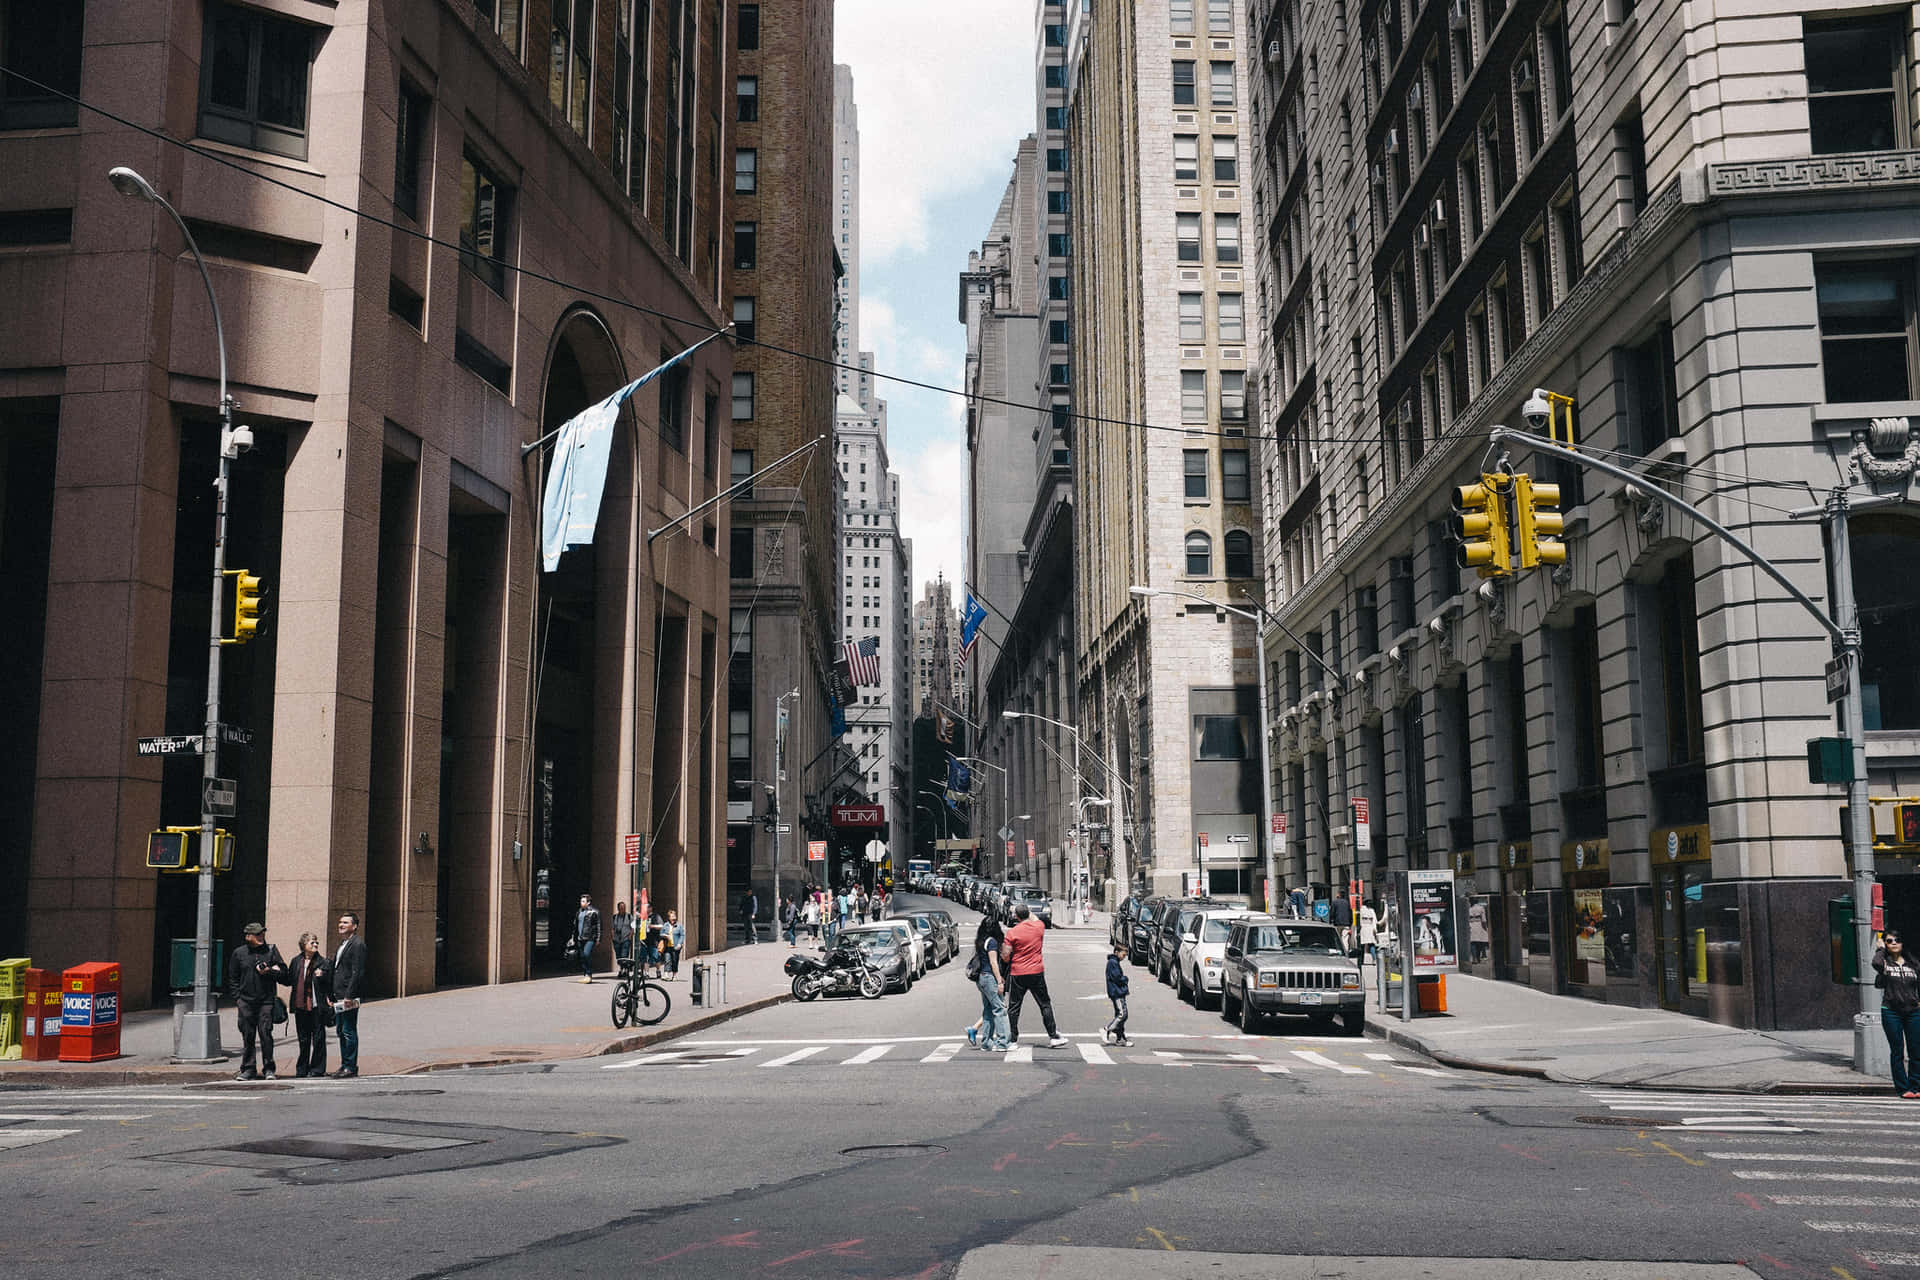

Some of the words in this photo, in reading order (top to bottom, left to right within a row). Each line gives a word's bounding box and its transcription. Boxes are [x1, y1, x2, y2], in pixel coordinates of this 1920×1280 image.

[228, 730, 247, 744] WALL
[139, 742, 175, 754] WATER
[838, 810, 877, 822] TUMI
[66, 997, 91, 1010] VOICE
[96, 996, 116, 1010] VOICE
